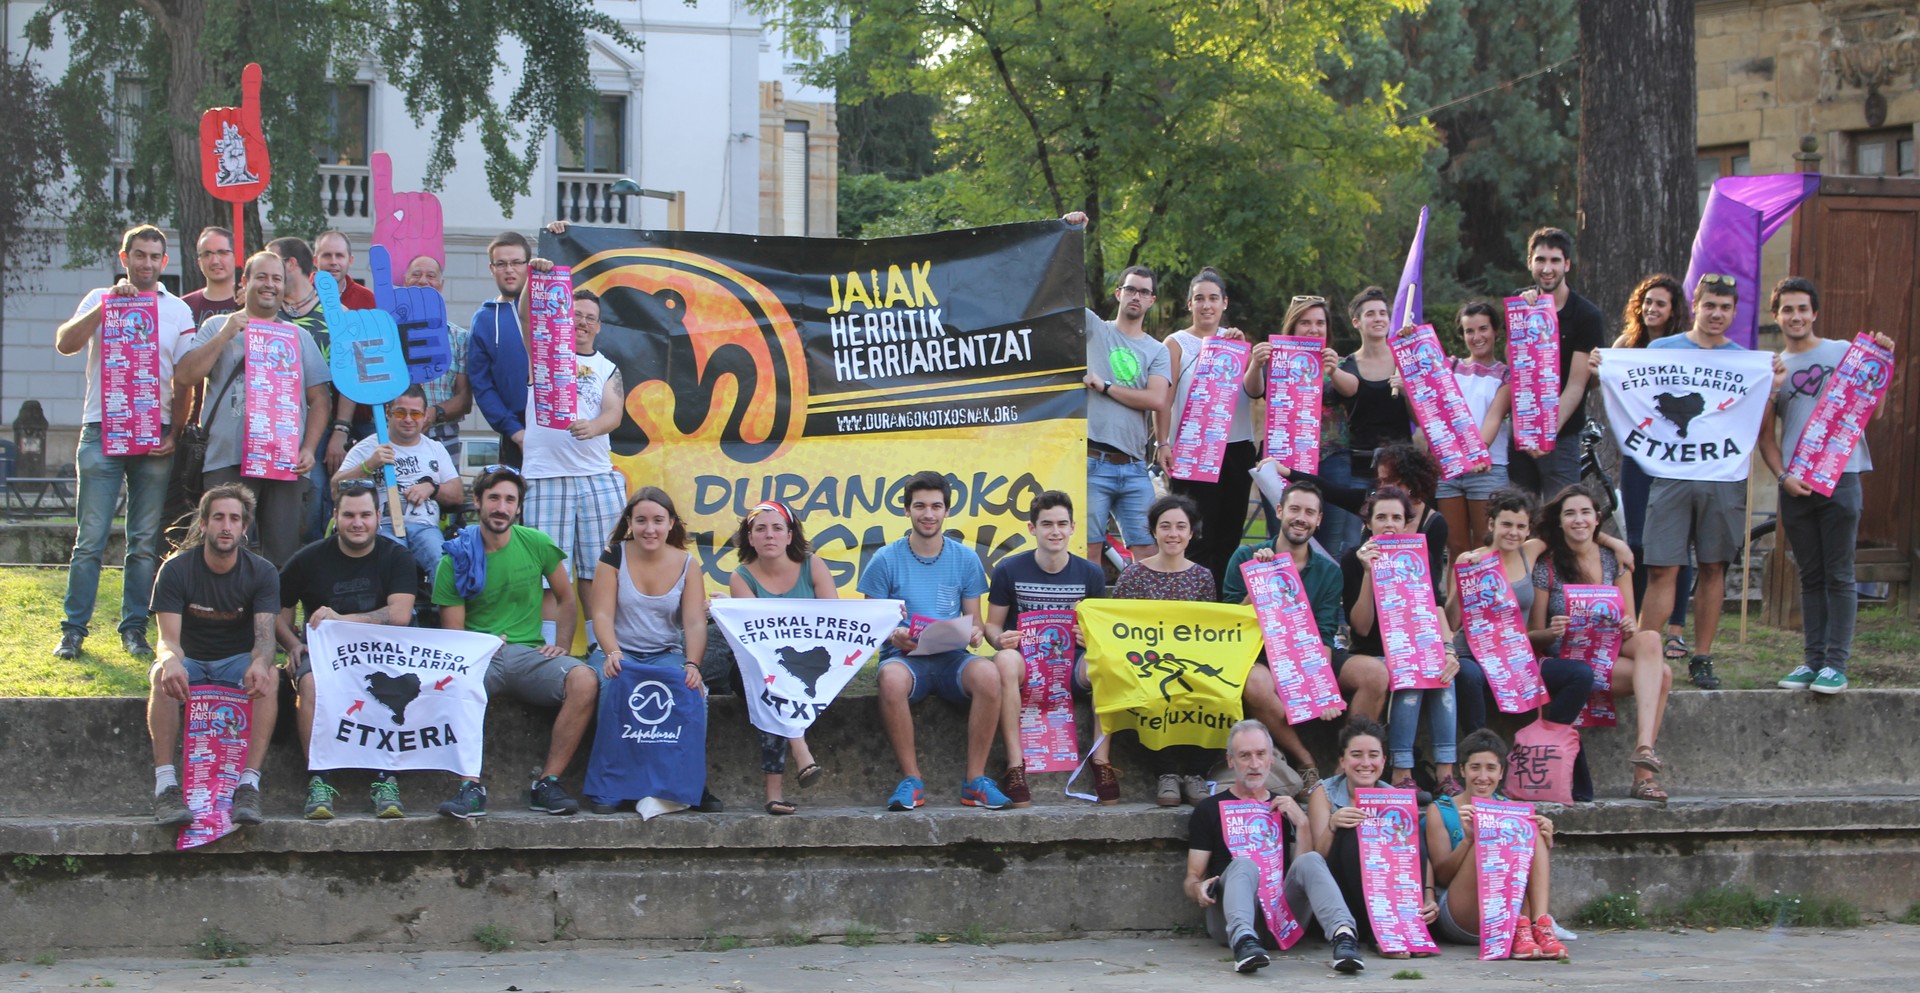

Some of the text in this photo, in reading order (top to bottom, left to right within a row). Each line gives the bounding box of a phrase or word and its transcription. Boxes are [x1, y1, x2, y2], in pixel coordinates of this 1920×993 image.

[532, 281, 544, 291] SAN
[827, 260, 939, 314] JAIAK
[105, 310, 120, 320] SAN
[1509, 313, 1523, 322] SAN
[830, 309, 946, 348] HERRITIK
[249, 334, 264, 344] SAN
[834, 328, 1032, 382] HERRIARENTZAT
[1201, 350, 1213, 358] SAN
[1272, 351, 1287, 360] SAN
[1396, 348, 1412, 360] SAN
[1850, 348, 1864, 359] SAN
[1627, 365, 1744, 384] EUSKAL PRESO
[1622, 375, 1748, 396] ETA IHESLARIAK
[836, 405, 1018, 432] WWW.DURANGOKOTXOSNAK.ORG
[1624, 429, 1741, 462] ETXERA
[1249, 576, 1265, 587] SAN
[1460, 577, 1476, 589] SAN
[1570, 600, 1586, 609] SAN
[744, 616, 871, 634] EUSKAL PRESO
[738, 628, 878, 648] ETA IHESLARIAK
[1022, 628, 1036, 637] SAN
[337, 641, 465, 663] EUSKAL PRESO
[332, 653, 470, 676] ETA IHESLARIAK
[191, 702, 209, 712] SAN
[335, 718, 458, 752] ETXERA
[1226, 816, 1244, 826] SAN
[1477, 813, 1495, 822] SAN
